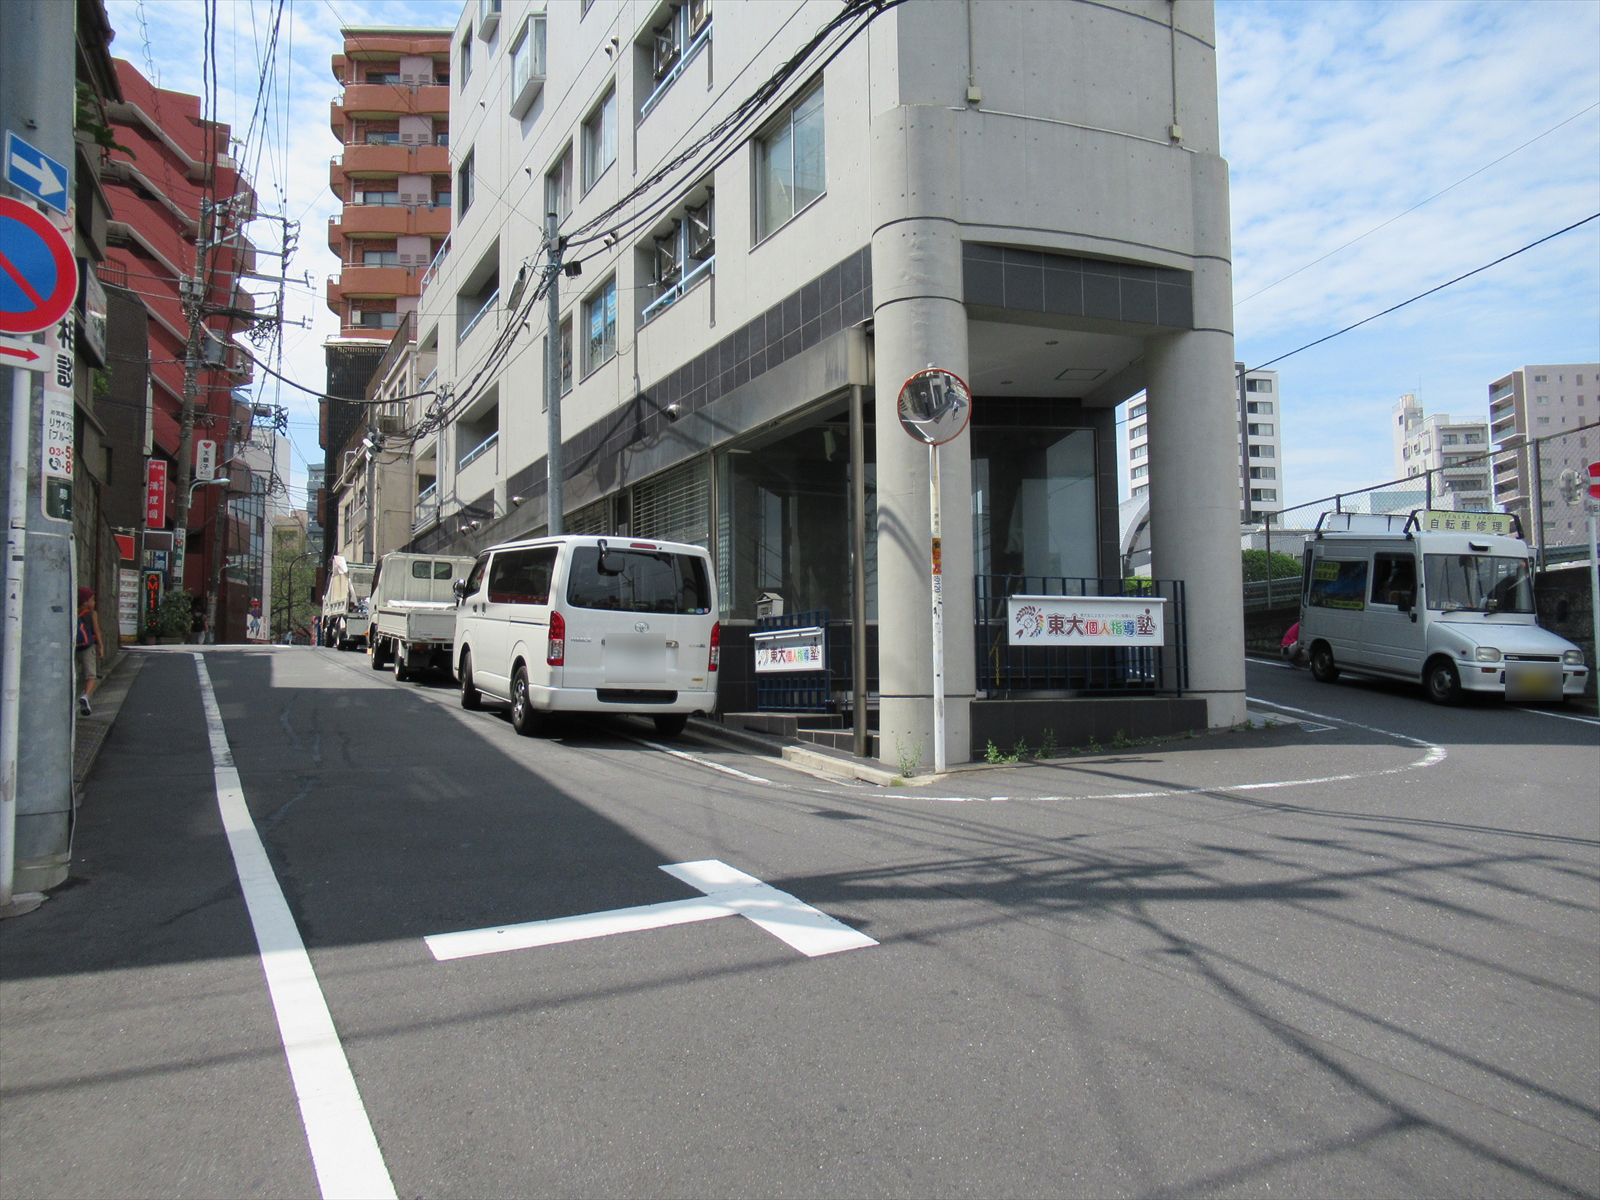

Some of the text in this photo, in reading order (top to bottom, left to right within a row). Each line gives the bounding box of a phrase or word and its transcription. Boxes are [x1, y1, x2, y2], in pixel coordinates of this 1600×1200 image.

[57, 317, 73, 388] 相談
[1430, 518, 1503, 532] 自転車修理
[1047, 608, 1156, 636] 東大個人指導塾
[771, 637, 819, 663] 東大個人指導塾
